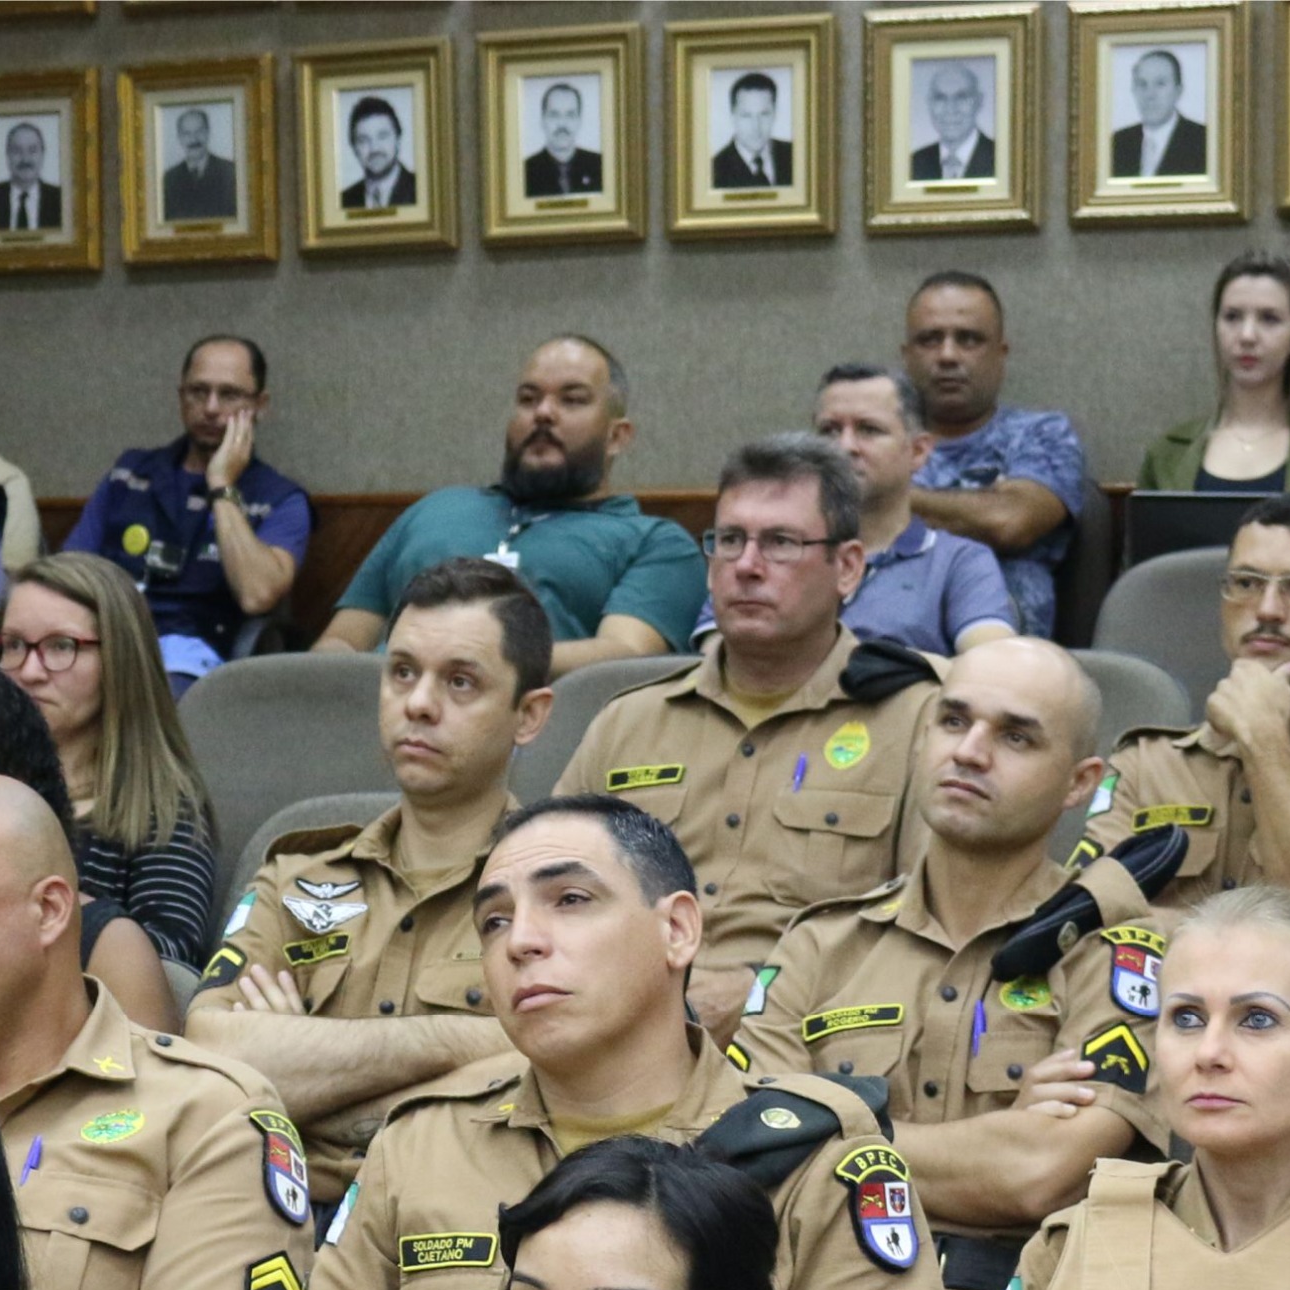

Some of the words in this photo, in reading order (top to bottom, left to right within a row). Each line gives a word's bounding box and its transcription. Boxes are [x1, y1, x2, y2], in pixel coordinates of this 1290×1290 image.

[854, 1151, 898, 1170] BPEC
[412, 1238, 454, 1253] SOLDADO
[456, 1237, 474, 1249] PM
[417, 1248, 464, 1264] CAETANO
